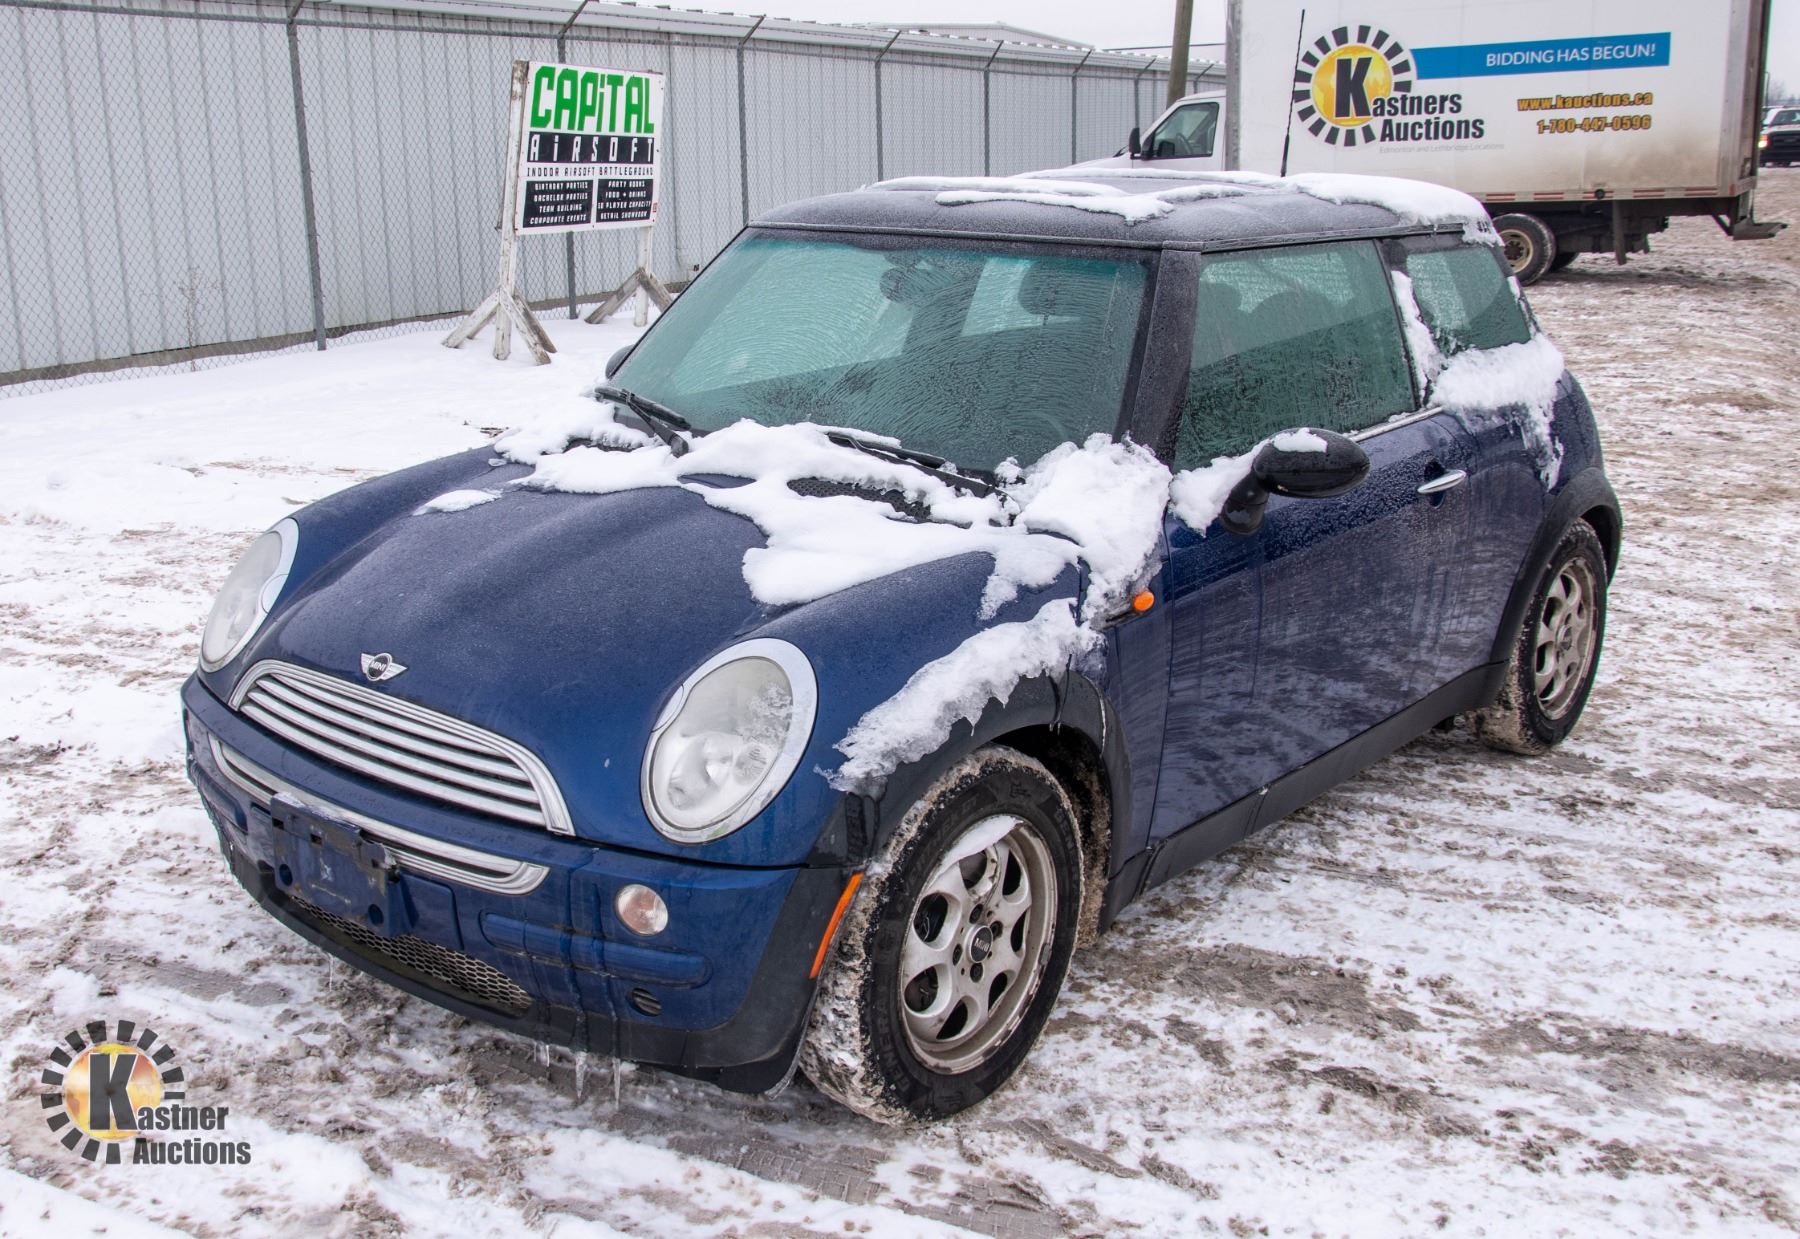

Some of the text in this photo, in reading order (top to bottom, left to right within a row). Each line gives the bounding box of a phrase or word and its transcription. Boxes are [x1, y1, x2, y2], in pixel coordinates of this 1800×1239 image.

[1486, 45, 1656, 67] BIDDING HAS BEGUN!
[1334, 56, 1462, 118] Kastners
[1517, 92, 1654, 111] www.kauctions.ca
[1379, 117, 1485, 142] Auctions
[1536, 115, 1652, 134] 1-780-447-0596
[527, 167, 560, 177] INDOOR
[599, 166, 653, 176] BATTLEGROUND
[534, 181, 588, 191] BIRTHDAY PARTIES
[608, 180, 645, 188] PARTY ROOMS
[533, 192, 588, 202] BACHELOR PARTIES
[605, 191, 620, 199] FOOD
[628, 190, 647, 198] DRINKS
[539, 203, 583, 213] TEAM BUILDING
[605, 201, 628, 209] PLAYER
[628, 200, 652, 208] CAPACITY
[529, 214, 587, 225] CORPORATE EVENTS
[600, 212, 619, 220] RETAIL
[369, 660, 387, 672] MINI
